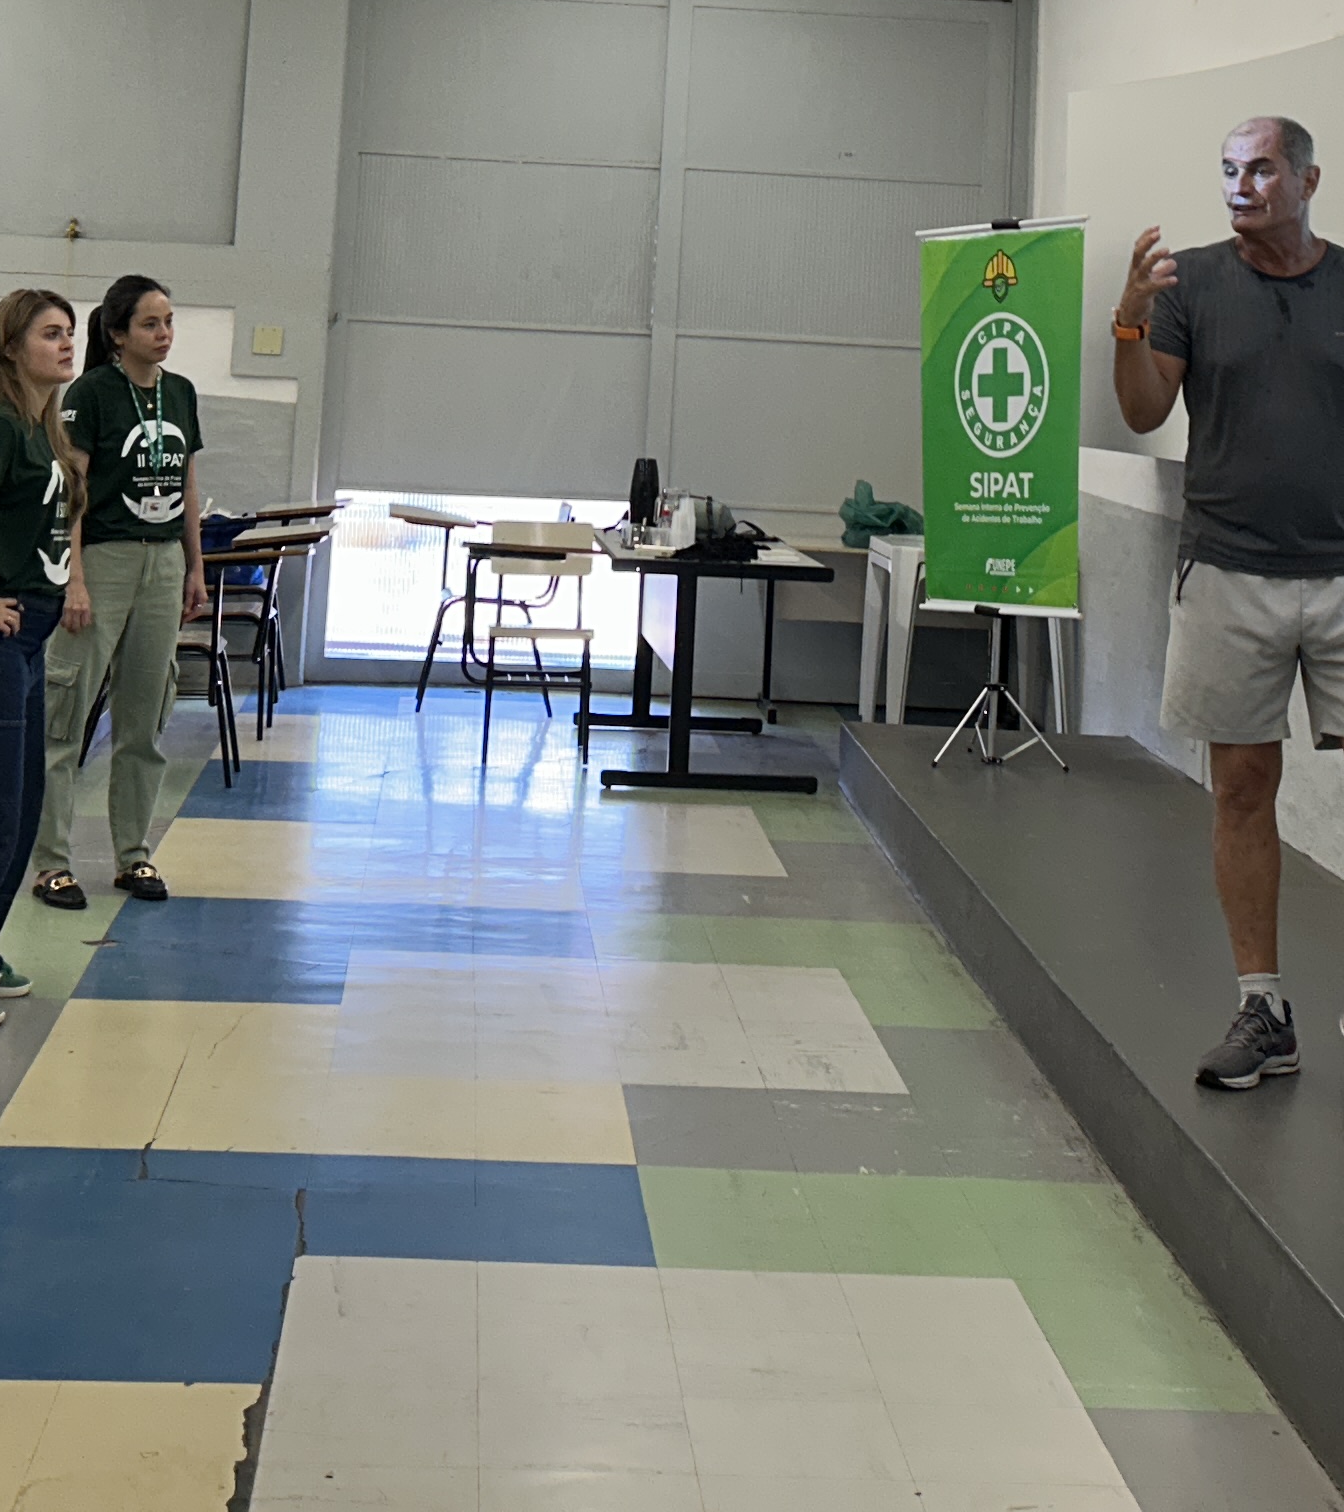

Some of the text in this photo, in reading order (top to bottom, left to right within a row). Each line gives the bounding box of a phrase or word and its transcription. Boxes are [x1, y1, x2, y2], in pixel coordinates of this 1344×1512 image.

[977, 321, 1025, 345] CIPA
[960, 384, 1044, 449] SEGURANÇA
[969, 471, 1034, 499] SIPAT
